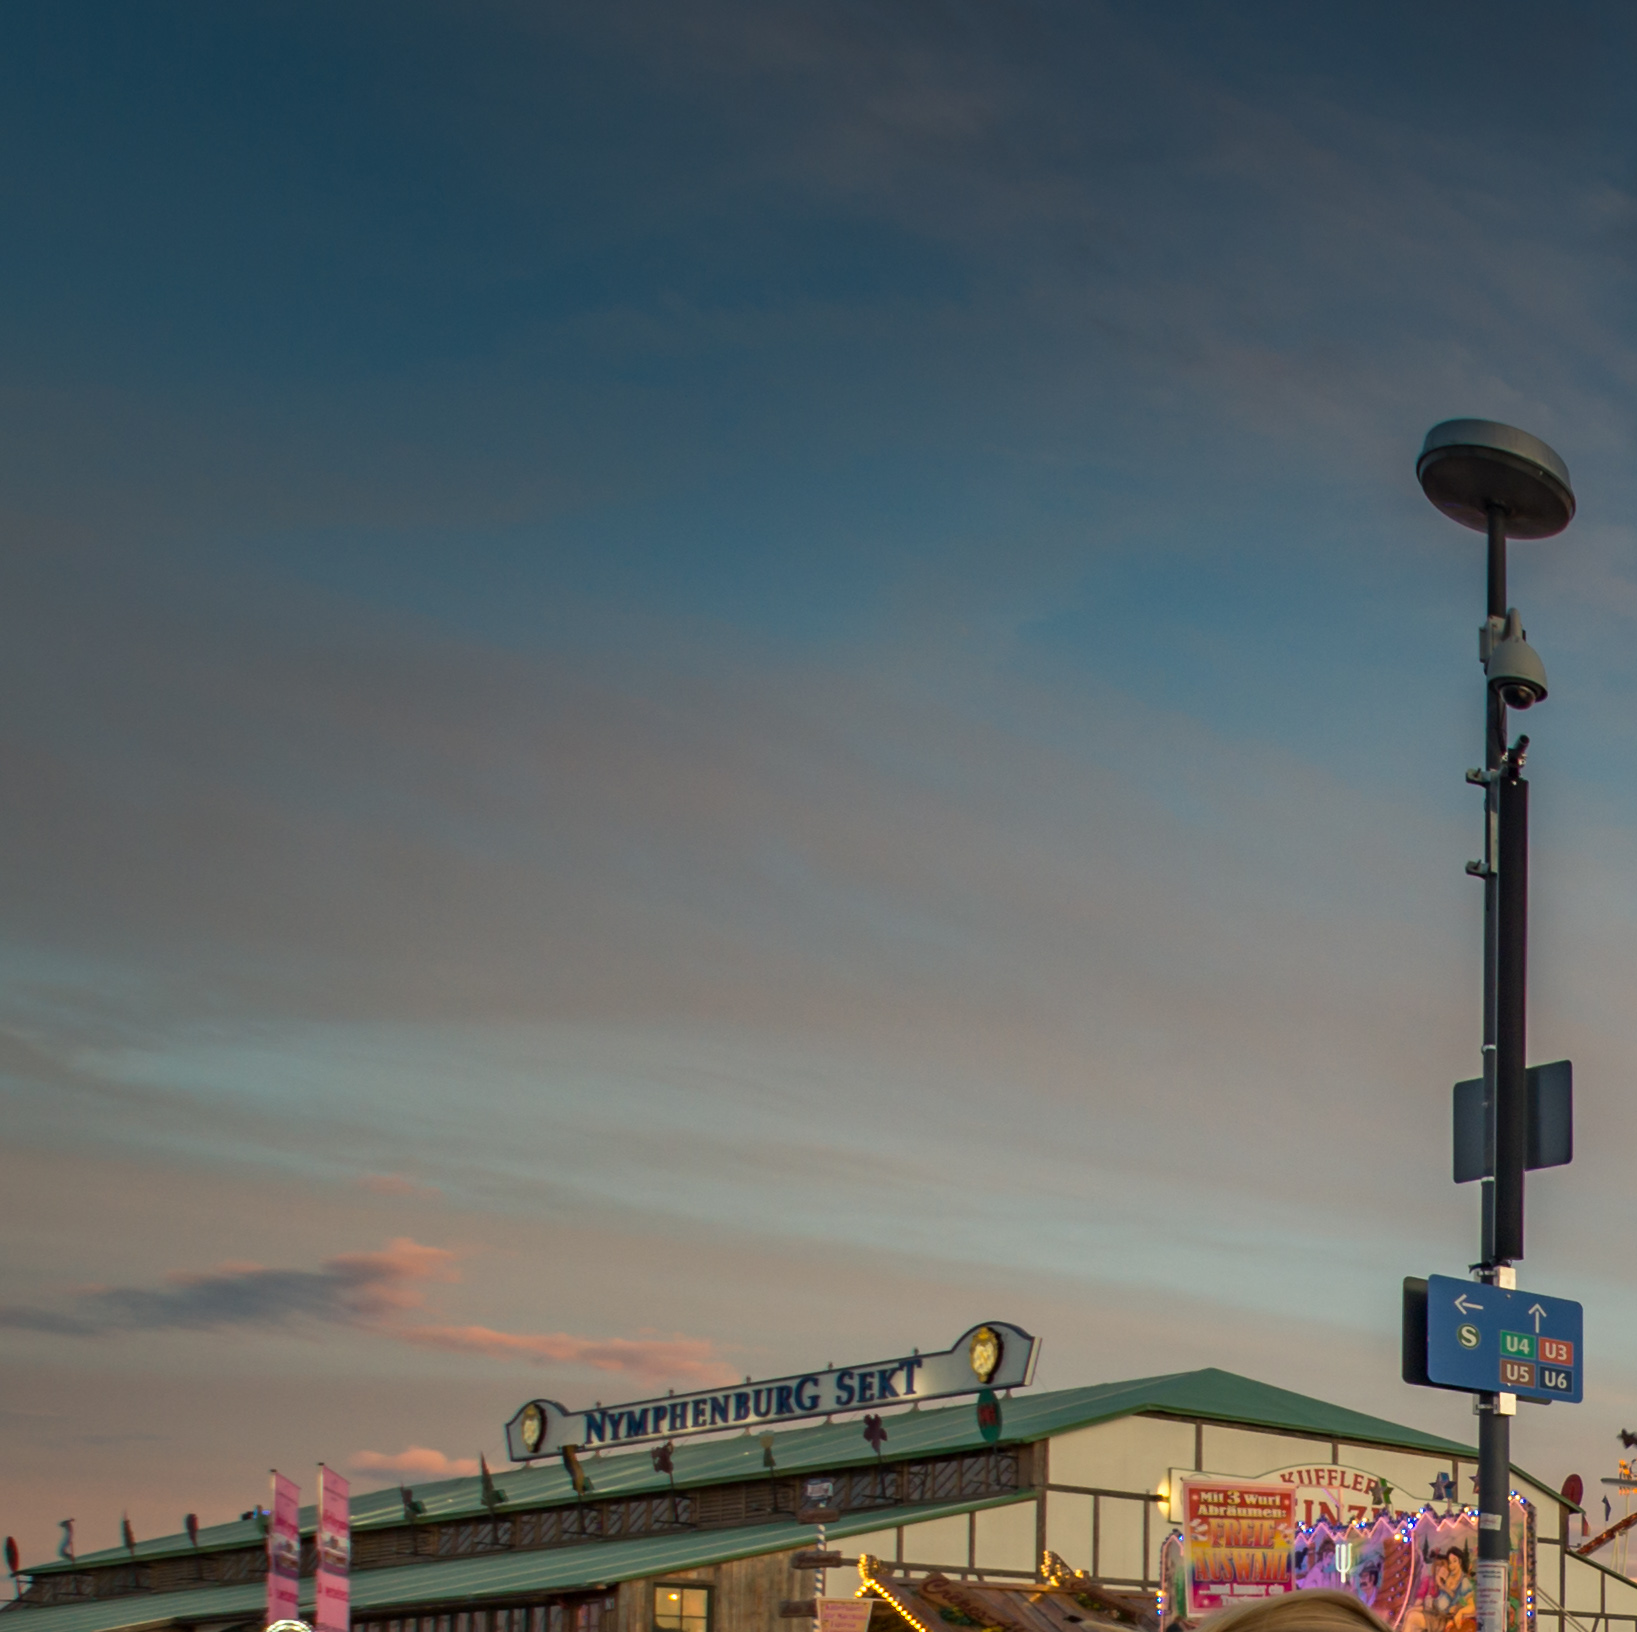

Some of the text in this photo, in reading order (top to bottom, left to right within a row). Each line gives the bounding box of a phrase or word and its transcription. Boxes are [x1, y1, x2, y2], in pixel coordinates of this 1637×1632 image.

[1461, 1325, 1477, 1347] S
[1506, 1335, 1567, 1361] U4 U3
[1506, 1364, 1567, 1389] U5 U6
[583, 1359, 923, 1445] NYMPHENBURG SEKT
[1200, 1490, 1281, 1506] Mit 3 Wurf
[1198, 1504, 1287, 1518] Abräumen:
[1208, 1518, 1275, 1549] FREIE
[1193, 1549, 1290, 1583] AUSWAHL
